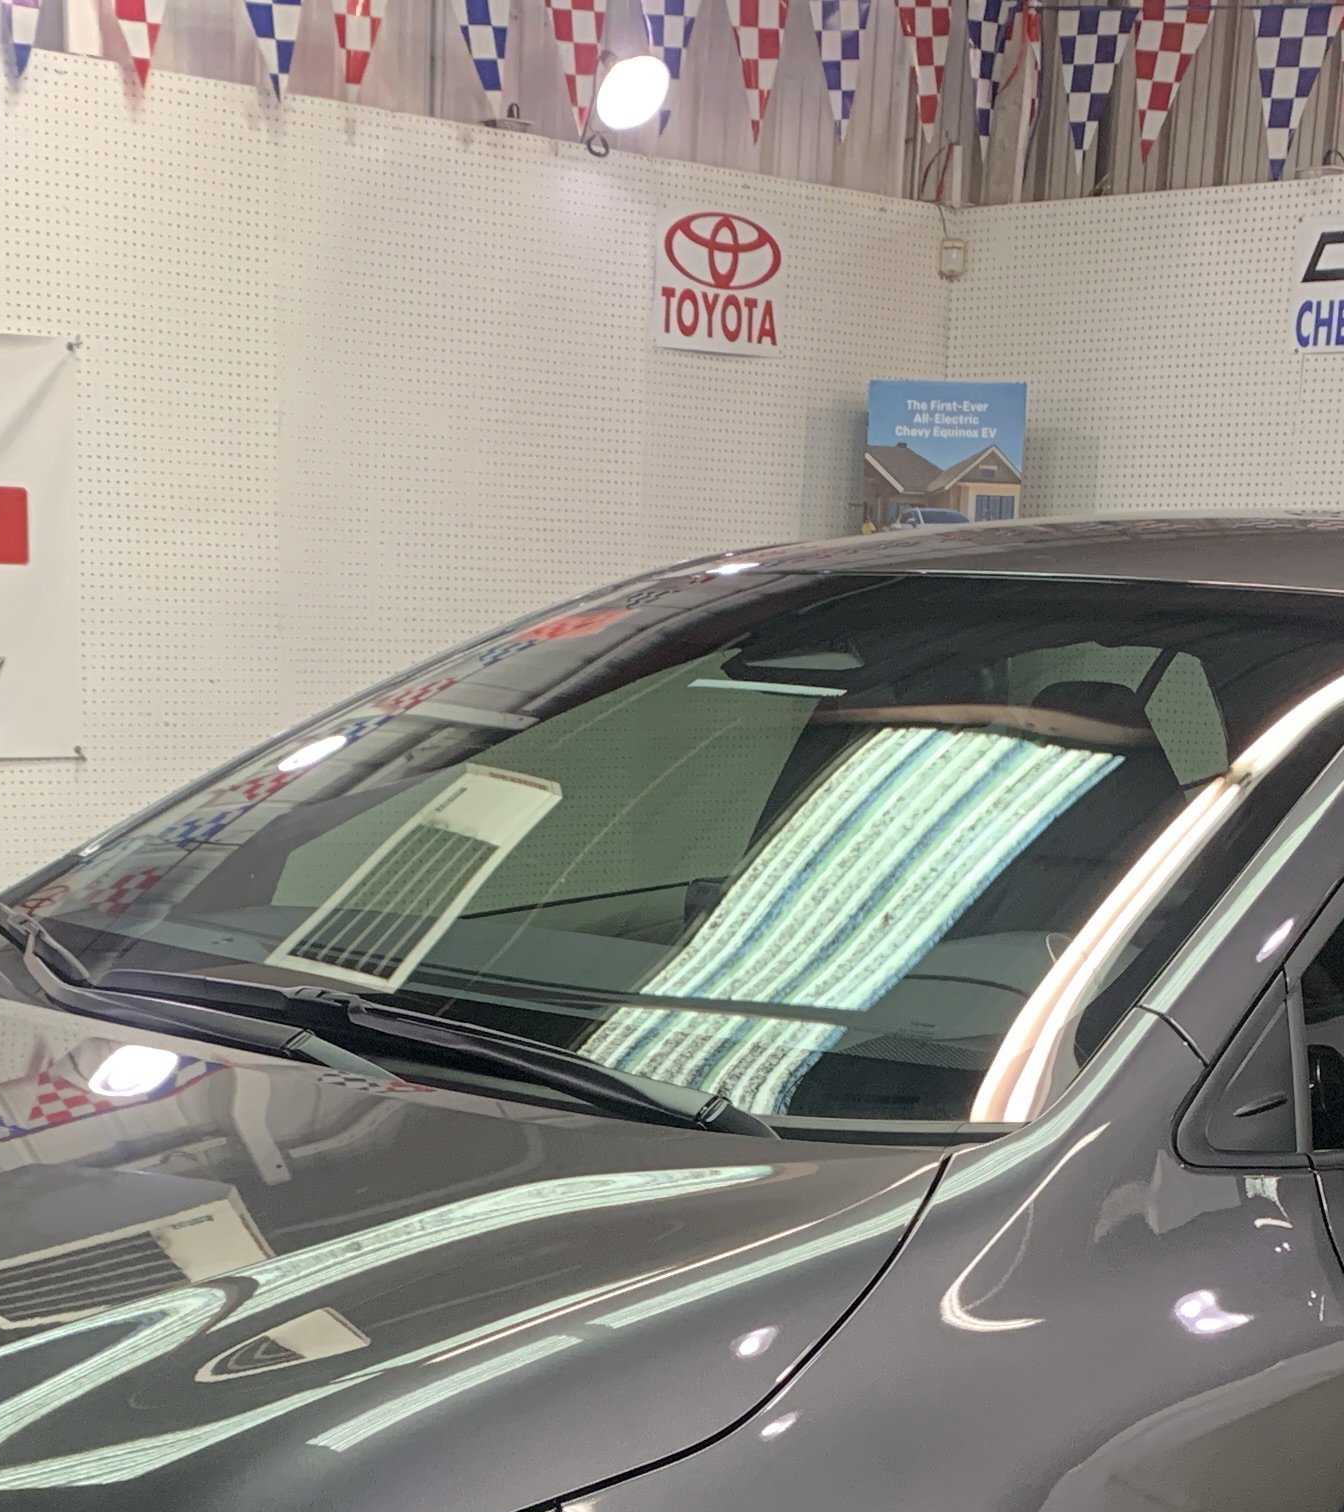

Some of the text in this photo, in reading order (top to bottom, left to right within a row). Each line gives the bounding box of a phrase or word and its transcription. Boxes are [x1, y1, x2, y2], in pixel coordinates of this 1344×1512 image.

[662, 286, 777, 346] TOYOTA
[906, 399, 990, 412] The First-Ever
[913, 413, 980, 425] All-Electric
[895, 425, 997, 439] Chevy Equinox EV
